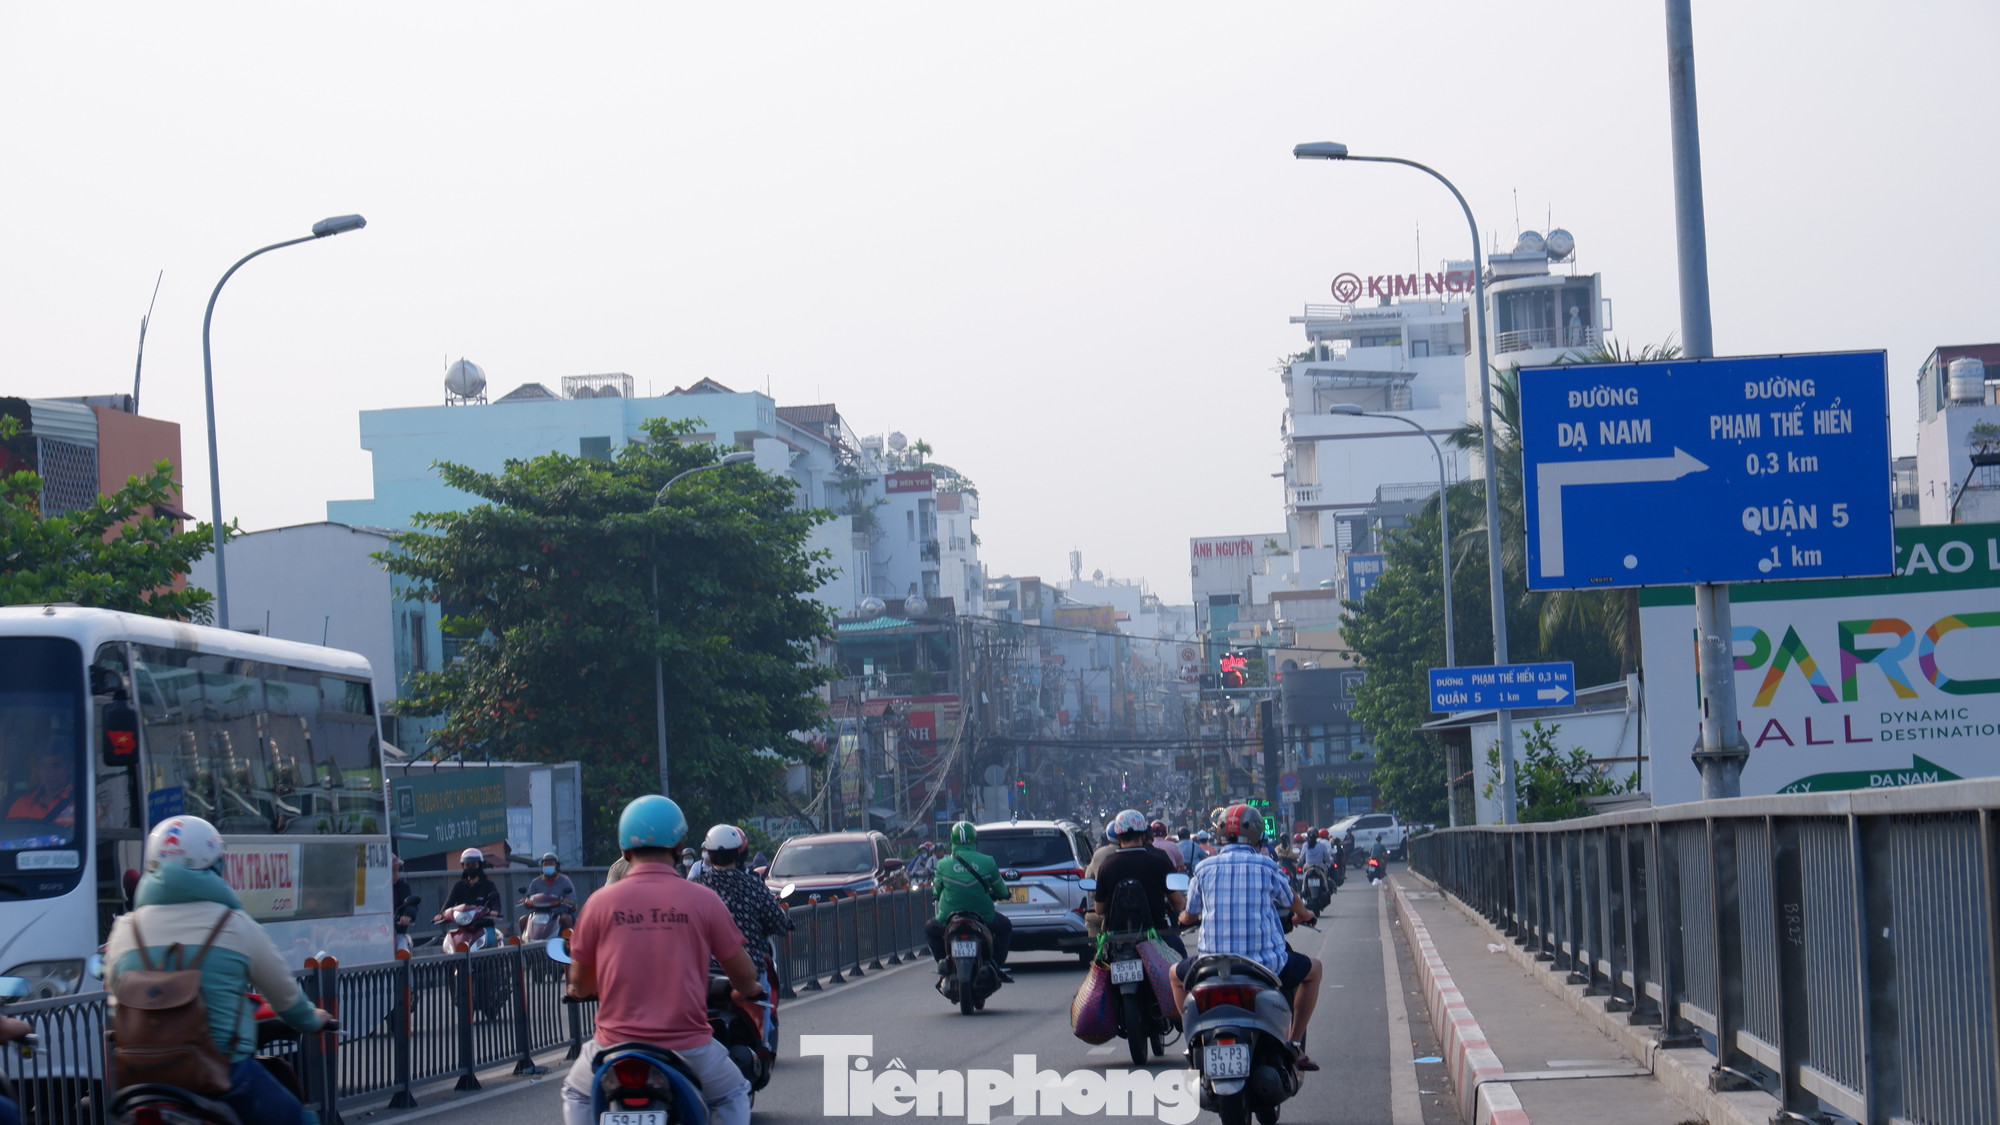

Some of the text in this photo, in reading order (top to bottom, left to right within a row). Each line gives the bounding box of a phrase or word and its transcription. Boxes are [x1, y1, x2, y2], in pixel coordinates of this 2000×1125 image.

[1368, 274, 1418, 298] KIM
[1568, 385, 1638, 408] ĐƯỜNG
[1745, 376, 1815, 399] ĐƯỜNG
[1710, 397, 1852, 445] PHẠM THẾ HIỂN
[1558, 419, 1651, 452] DẠ NAM
[1746, 451, 1818, 476] 0,3 km
[1742, 498, 1849, 536] QUẬN 5
[1193, 540, 1212, 557] ÁNH
[1770, 545, 1822, 567] 1 km
[1896, 541, 1974, 576] AO
[1437, 667, 1567, 687] ĐƯỜNG PHẠM THẾ HIỂN 0,3 km
[1437, 691, 1519, 707] QUẬN 5 1 km
[1880, 707, 1969, 724] DYNAMIC
[1881, 724, 2000, 742] DESTINATIO
[1897, 771, 1938, 785] NAM
[247, 853, 292, 889] TRAVEL
[1211, 1062, 1242, 1076] 3943
